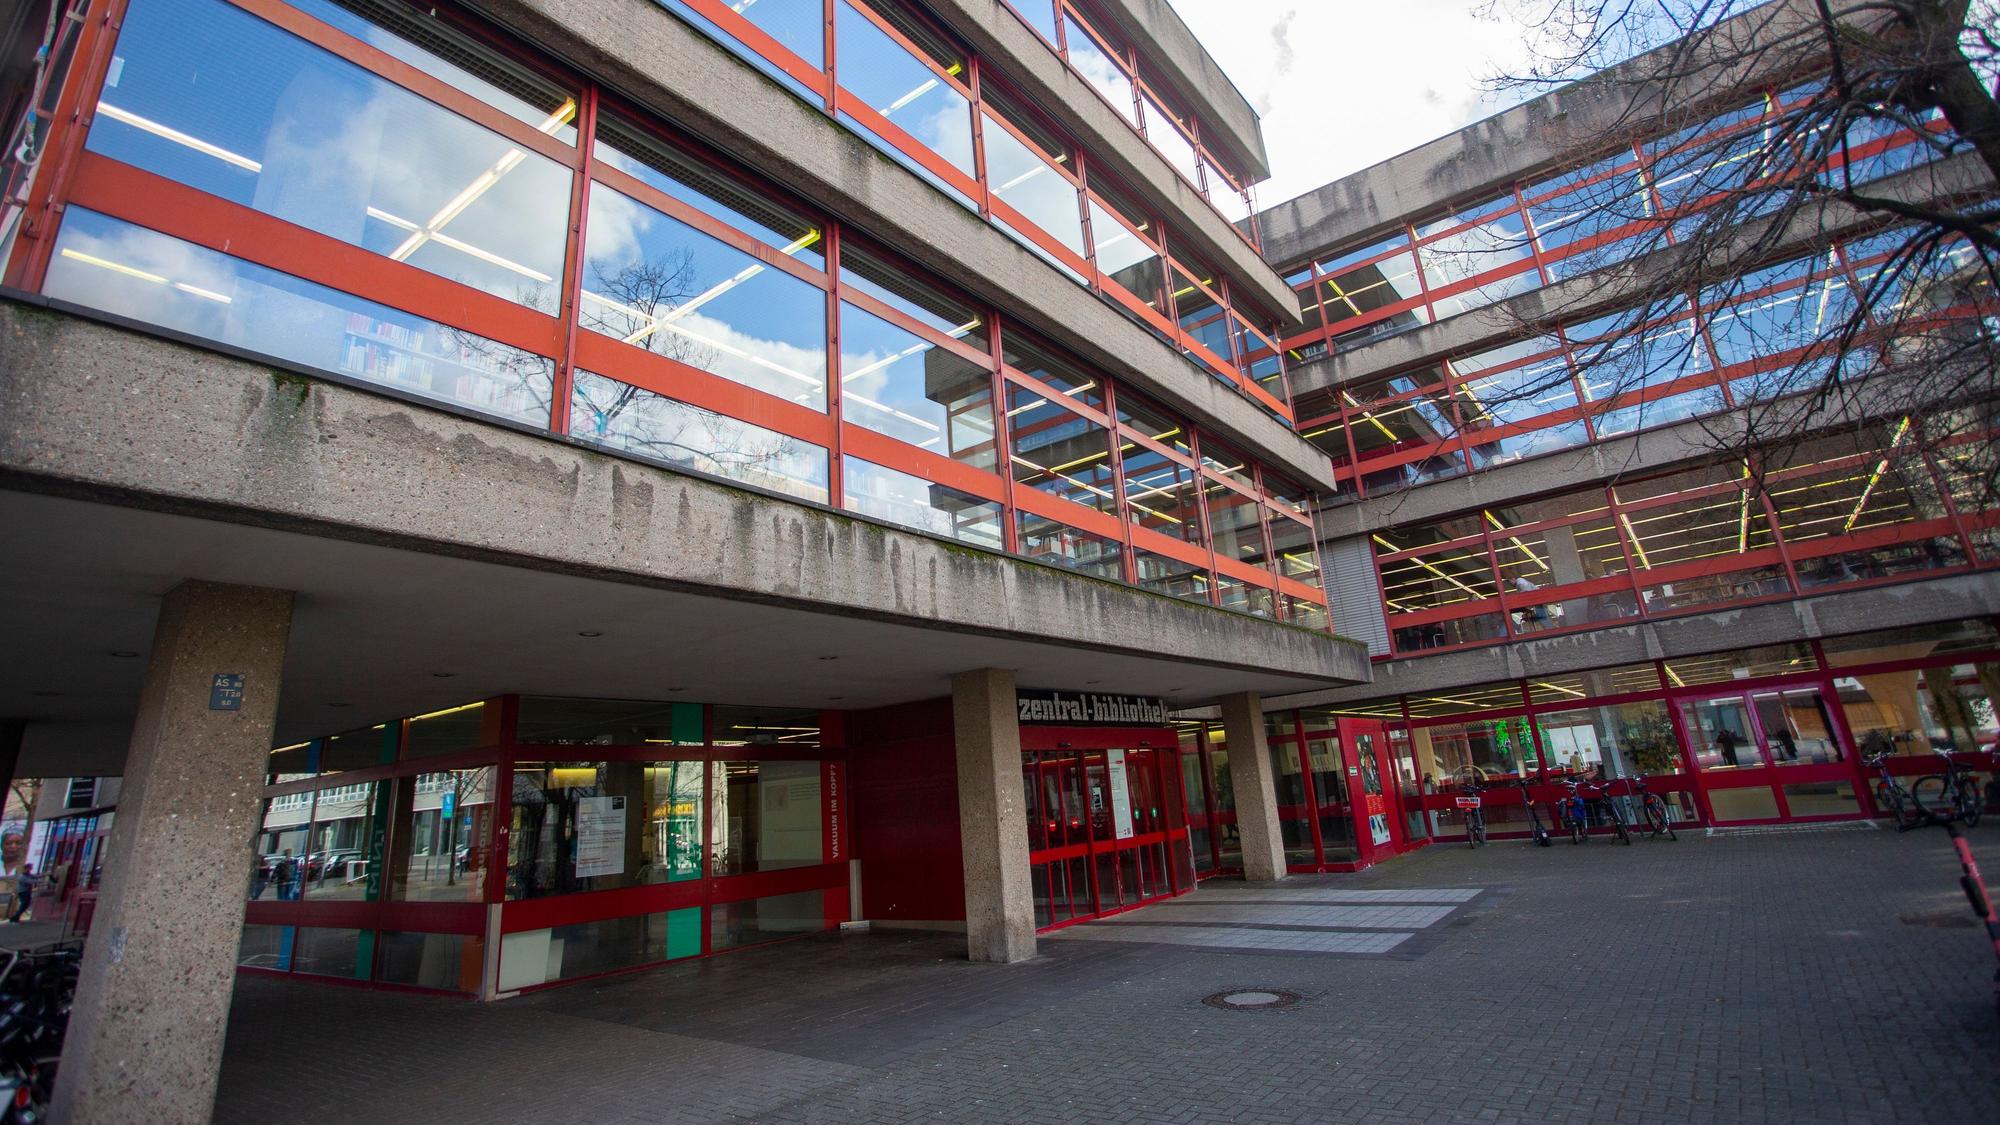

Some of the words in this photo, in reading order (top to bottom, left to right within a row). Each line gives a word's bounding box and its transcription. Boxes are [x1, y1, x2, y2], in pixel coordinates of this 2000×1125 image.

[215, 678, 230, 687] AS
[1018, 691, 1170, 724] zentral-bibliothek
[829, 763, 837, 797] KOPF?
[830, 799, 838, 812] IM
[831, 814, 839, 859] VAKUUM
